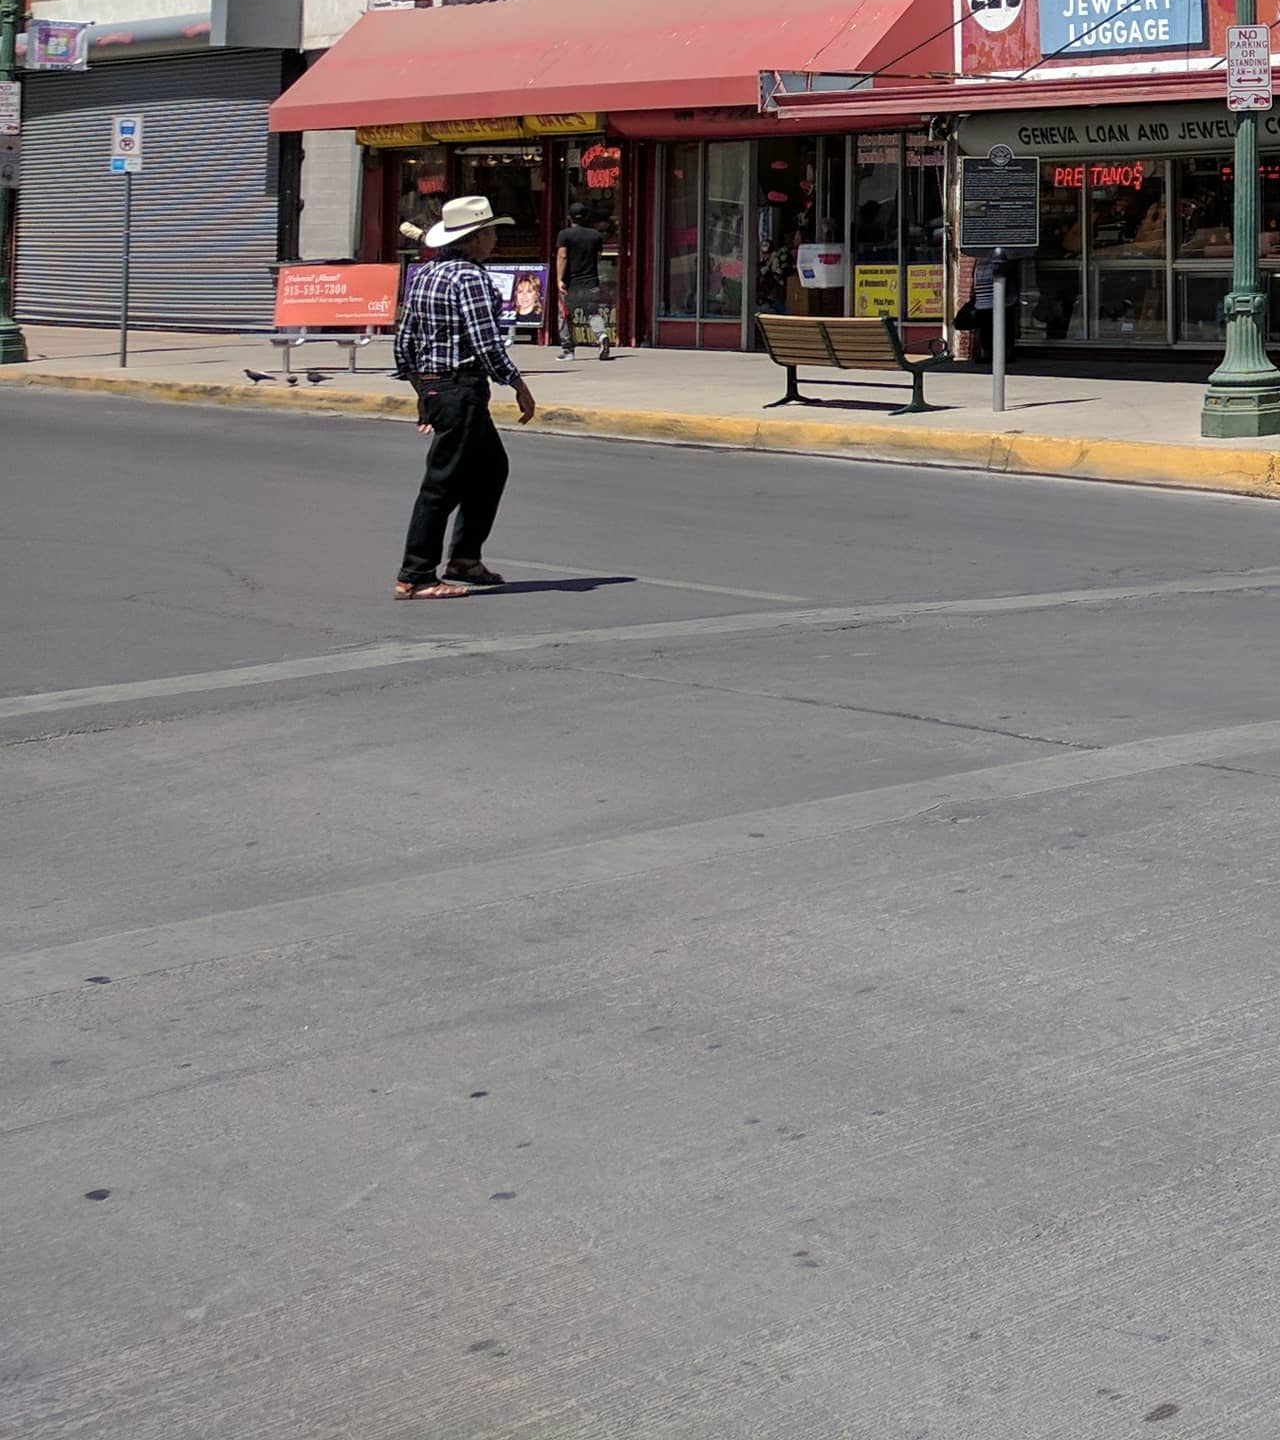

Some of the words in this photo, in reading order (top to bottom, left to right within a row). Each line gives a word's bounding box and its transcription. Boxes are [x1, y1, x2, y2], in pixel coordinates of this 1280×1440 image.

[1068, 19, 1170, 49] LUGGAGE
[1238, 30, 1258, 41] NO
[1230, 40, 1268, 49] PARKING
[1241, 49, 1256, 58] OR
[1230, 59, 1267, 67] STANDING
[1018, 122, 1078, 146] GENEVA
[1085, 123, 1135, 144] LOAN
[1137, 122, 1170, 142] AND
[1178, 120, 1236, 140] JEWEL
[1053, 160, 1144, 191] PRETAMO$
